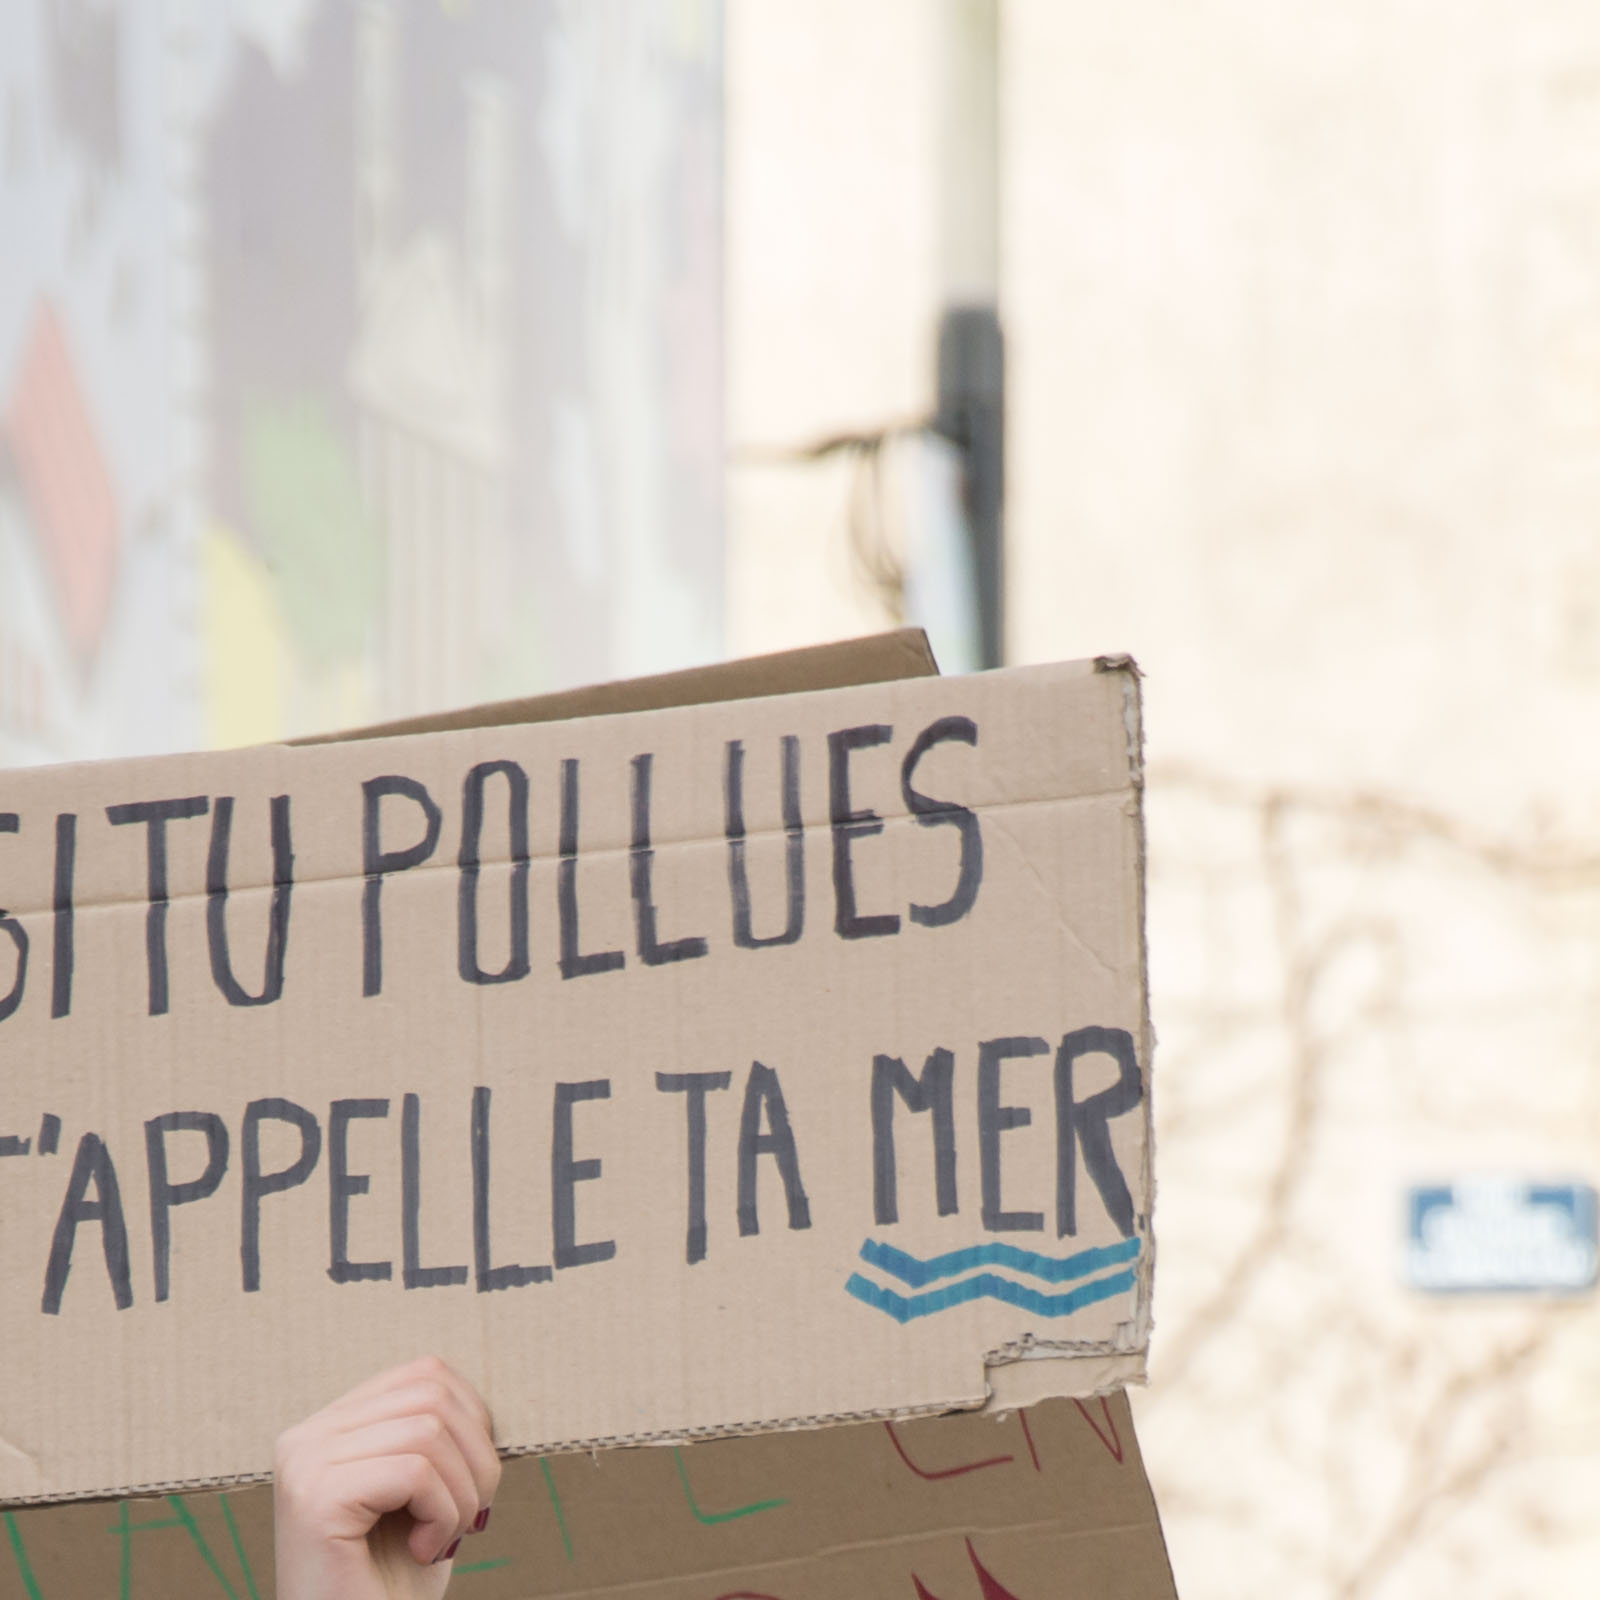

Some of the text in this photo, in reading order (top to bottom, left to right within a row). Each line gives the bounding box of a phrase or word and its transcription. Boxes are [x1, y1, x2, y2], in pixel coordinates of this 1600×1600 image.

[360, 715, 984, 998] POLLUES
[655, 1060, 812, 1265] TA
[869, 1024, 1143, 1238] MER
